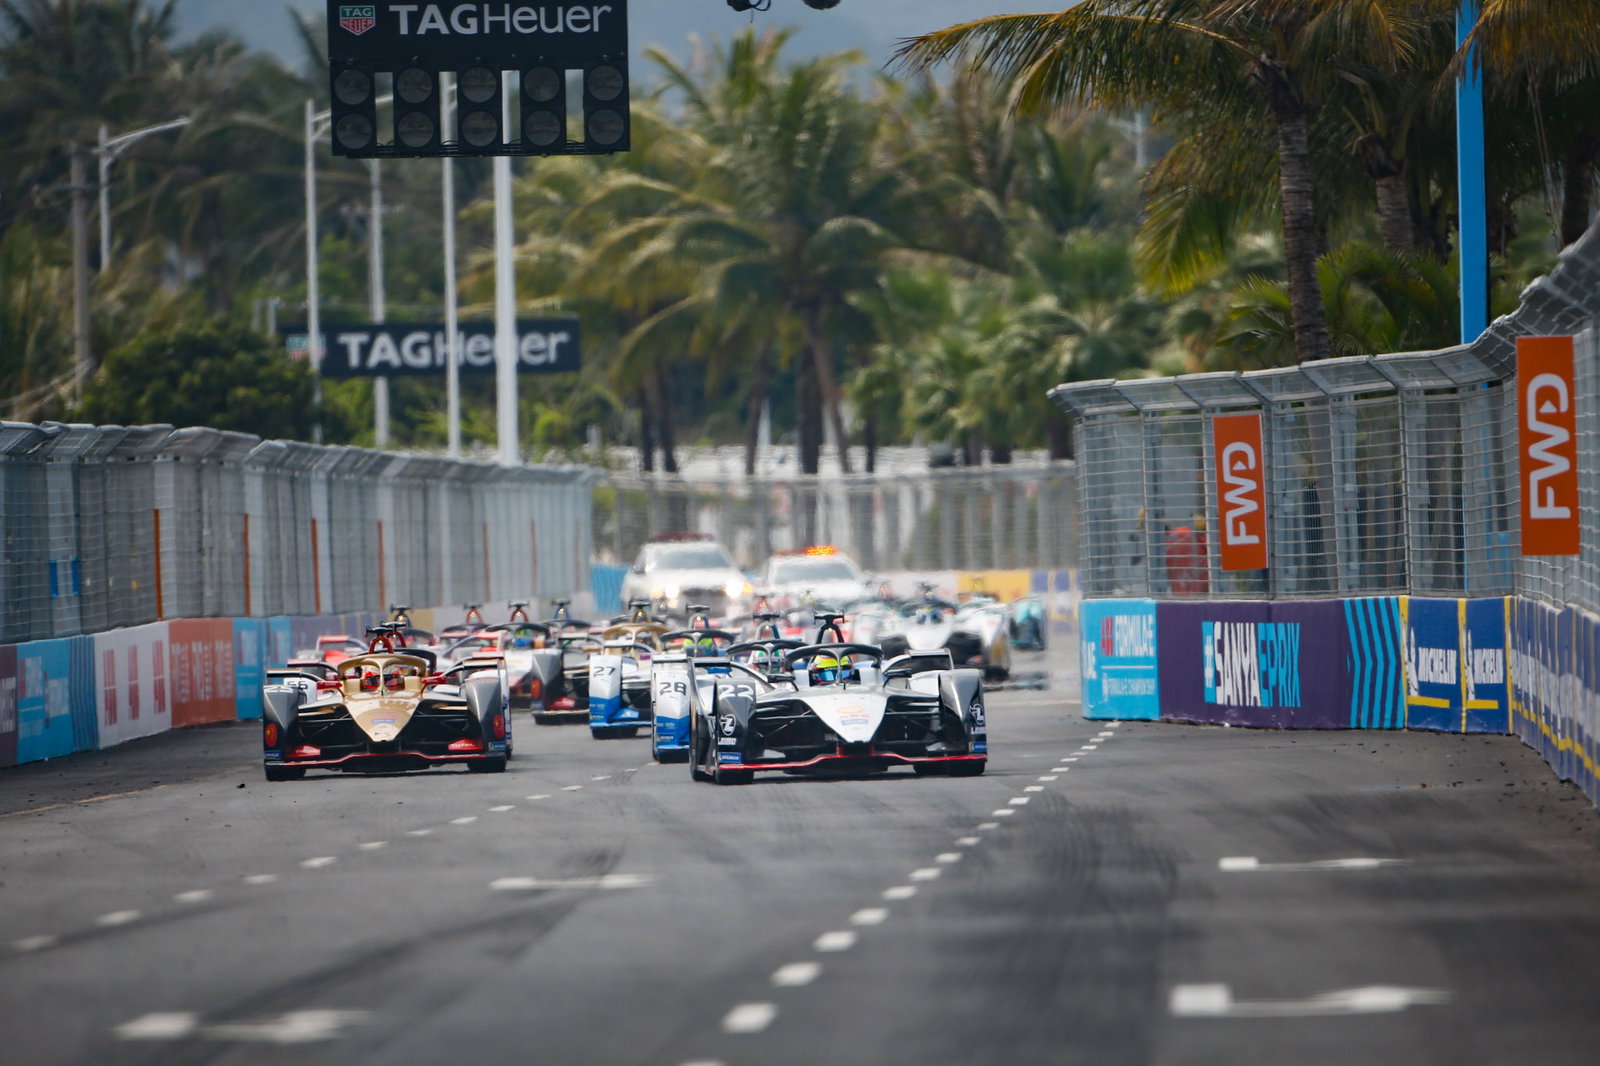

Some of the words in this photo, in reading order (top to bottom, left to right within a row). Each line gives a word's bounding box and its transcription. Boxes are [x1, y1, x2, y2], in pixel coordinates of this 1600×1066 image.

[342, 7, 373, 17] TAG
[341, 18, 375, 34] HEUER
[337, 331, 569, 369] TAGHeer
[1526, 372, 1571, 520] FWD
[1222, 441, 1260, 546] FWD
[593, 666, 616, 677] 27
[660, 681, 687, 696] 28
[718, 684, 754, 701] 22
